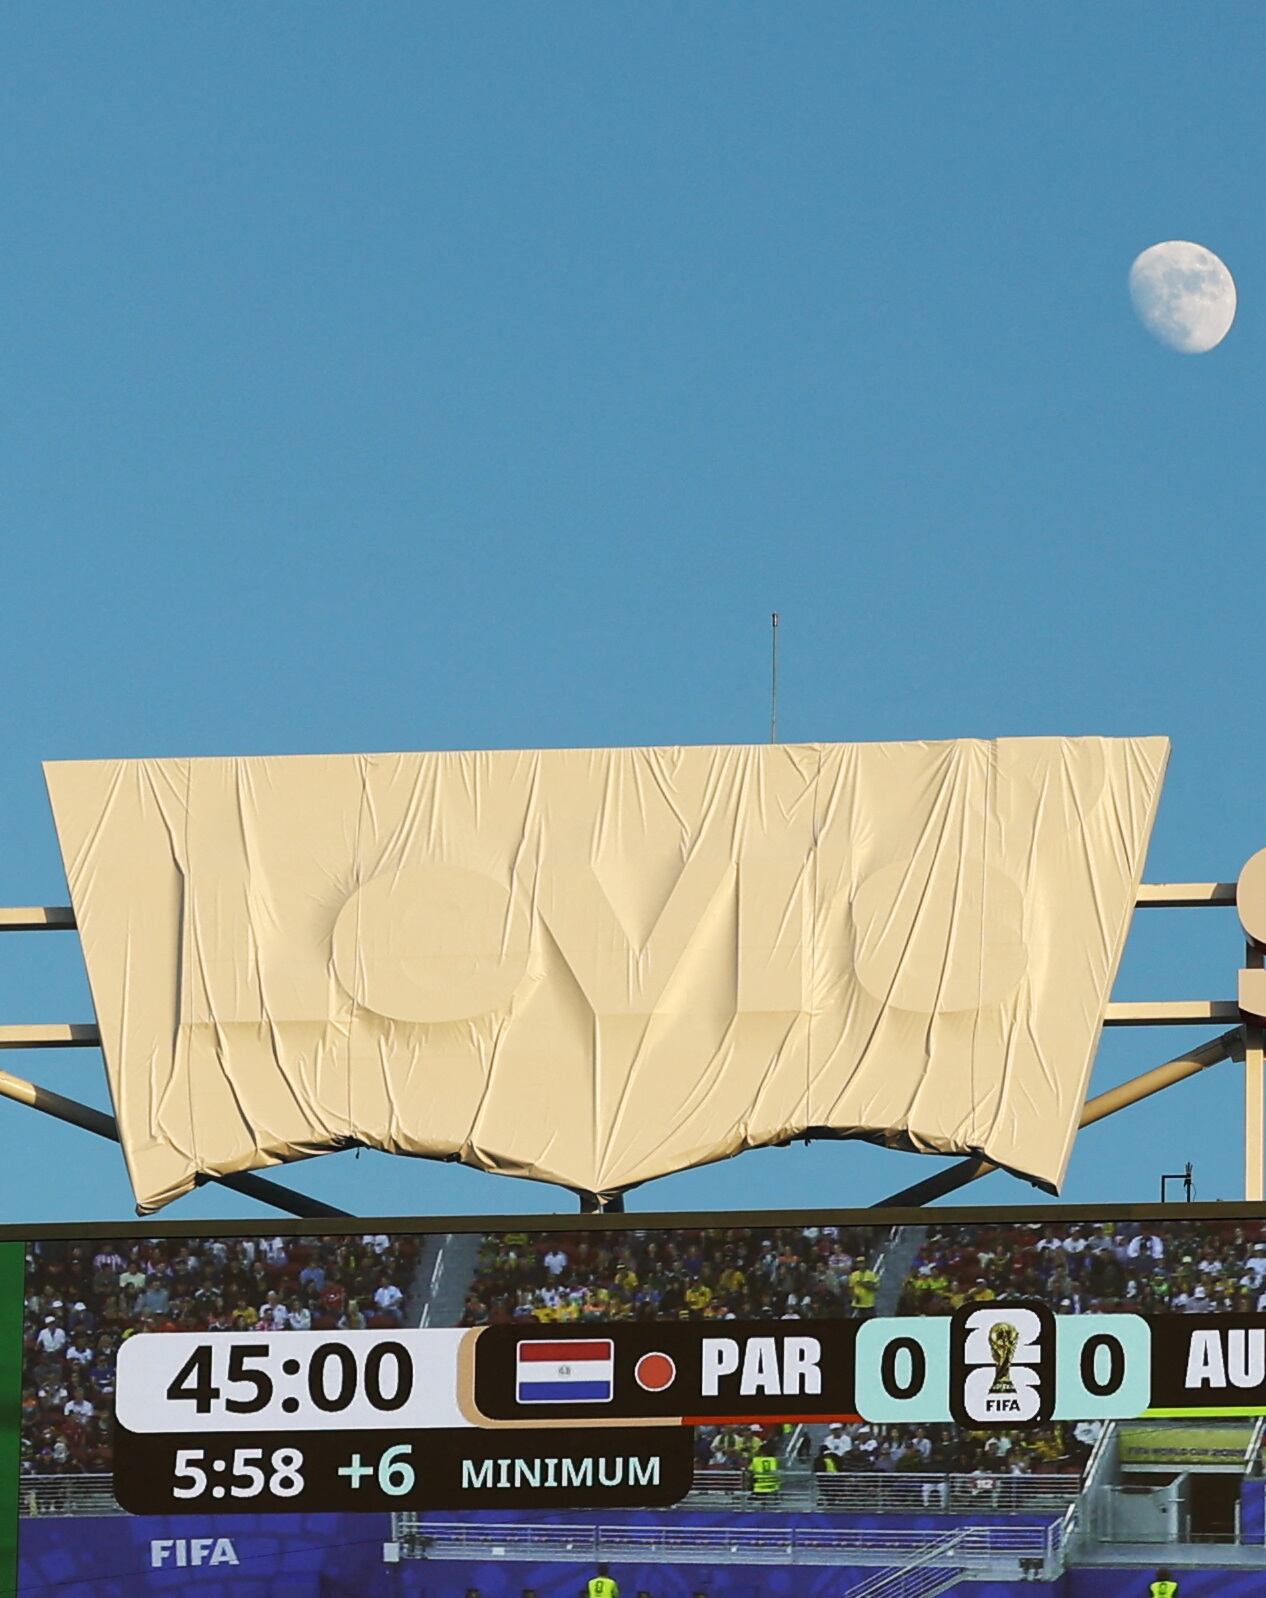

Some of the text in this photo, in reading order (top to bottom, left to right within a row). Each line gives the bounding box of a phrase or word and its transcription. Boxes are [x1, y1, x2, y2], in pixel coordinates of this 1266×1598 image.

[165, 1340, 415, 1415] 45:00
[701, 1336, 926, 1399] PAR 0
[1081, 1333, 1126, 1396] 0
[985, 1400, 1021, 1412] FIFA
[172, 1444, 661, 1498] 5:58 +6 MINIMUM
[150, 1537, 240, 1568] FIFA
